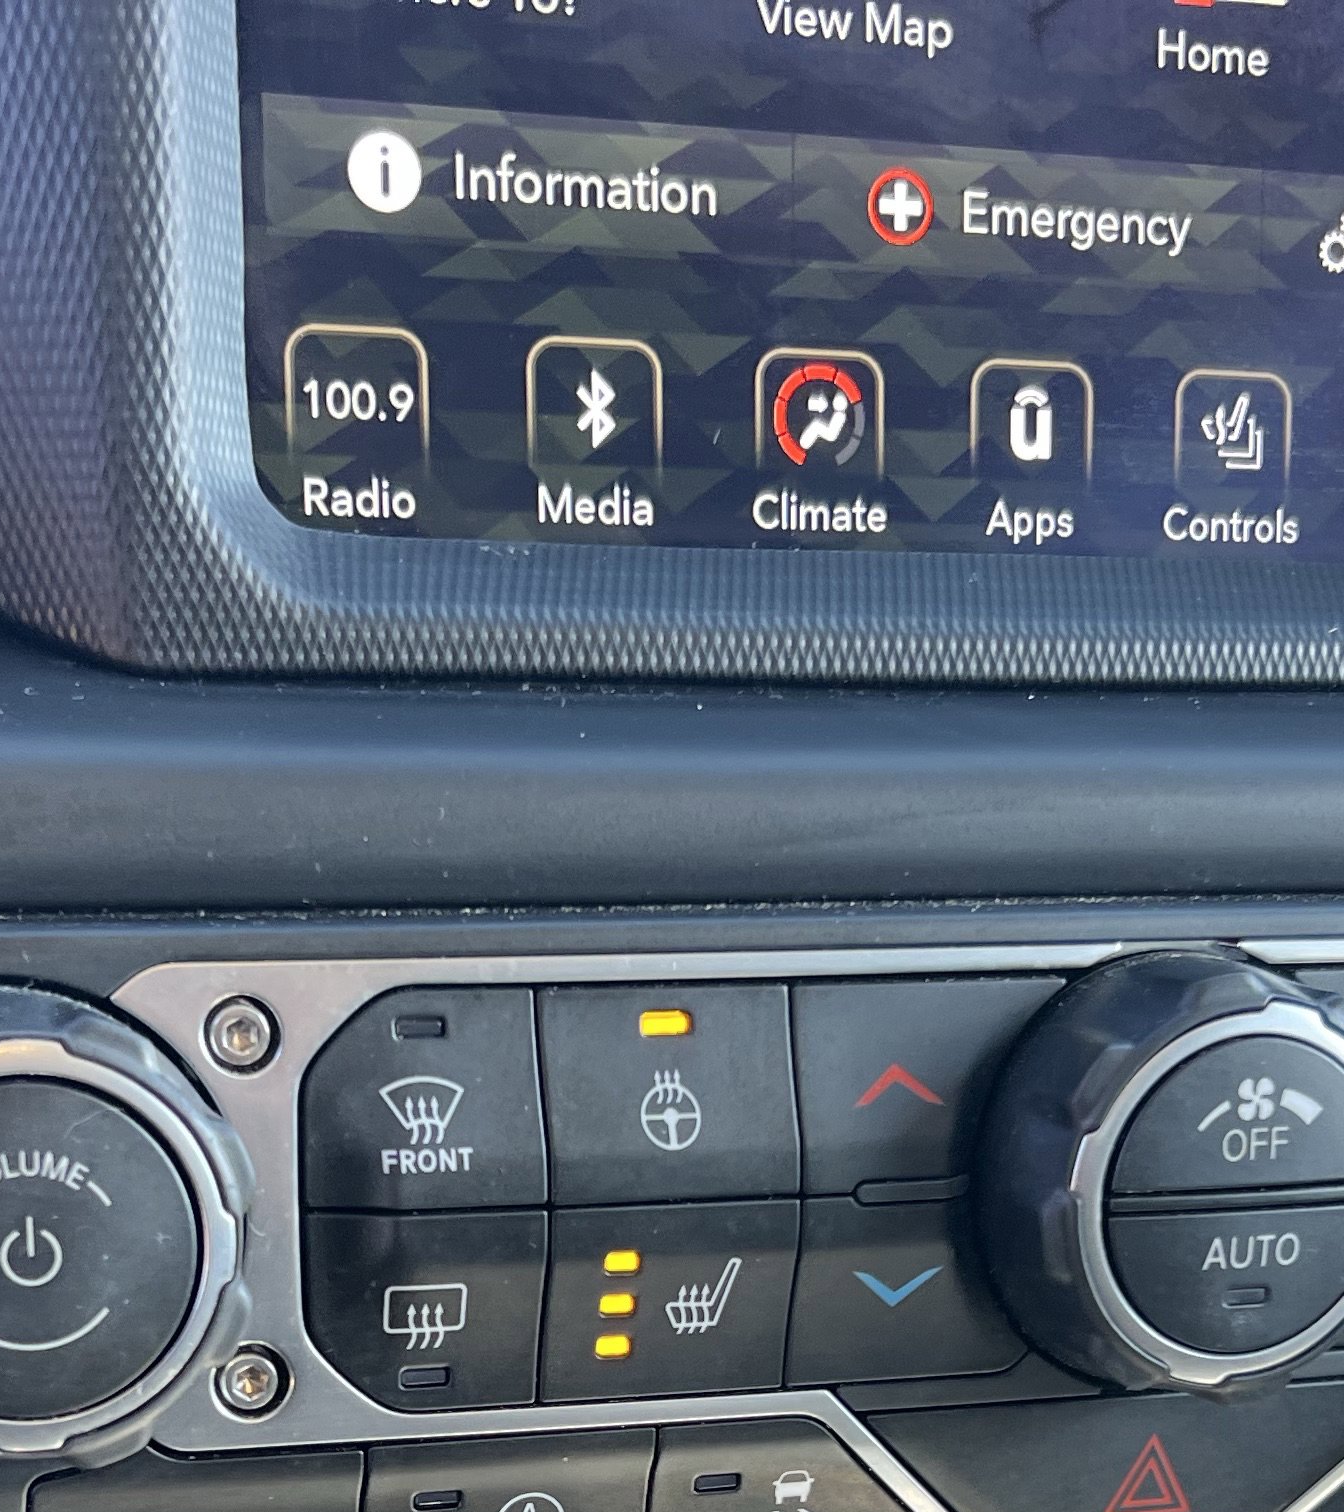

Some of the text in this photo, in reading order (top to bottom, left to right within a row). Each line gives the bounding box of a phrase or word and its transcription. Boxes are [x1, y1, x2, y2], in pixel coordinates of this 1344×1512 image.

[756, 0, 954, 59] View Map
[1157, 27, 1270, 77] Home
[454, 150, 717, 217] Information
[962, 190, 1193, 257] Emergency
[302, 377, 415, 422] 100.9
[303, 475, 416, 519] Radio
[537, 482, 654, 527] Media
[752, 490, 888, 533] Climate
[986, 500, 1074, 540] Apps
[1163, 506, 1298, 544] Controls
[381, 1146, 474, 1175] FRONT
[1222, 1125, 1291, 1163] OFF
[1201, 1232, 1301, 1271] AUTO
